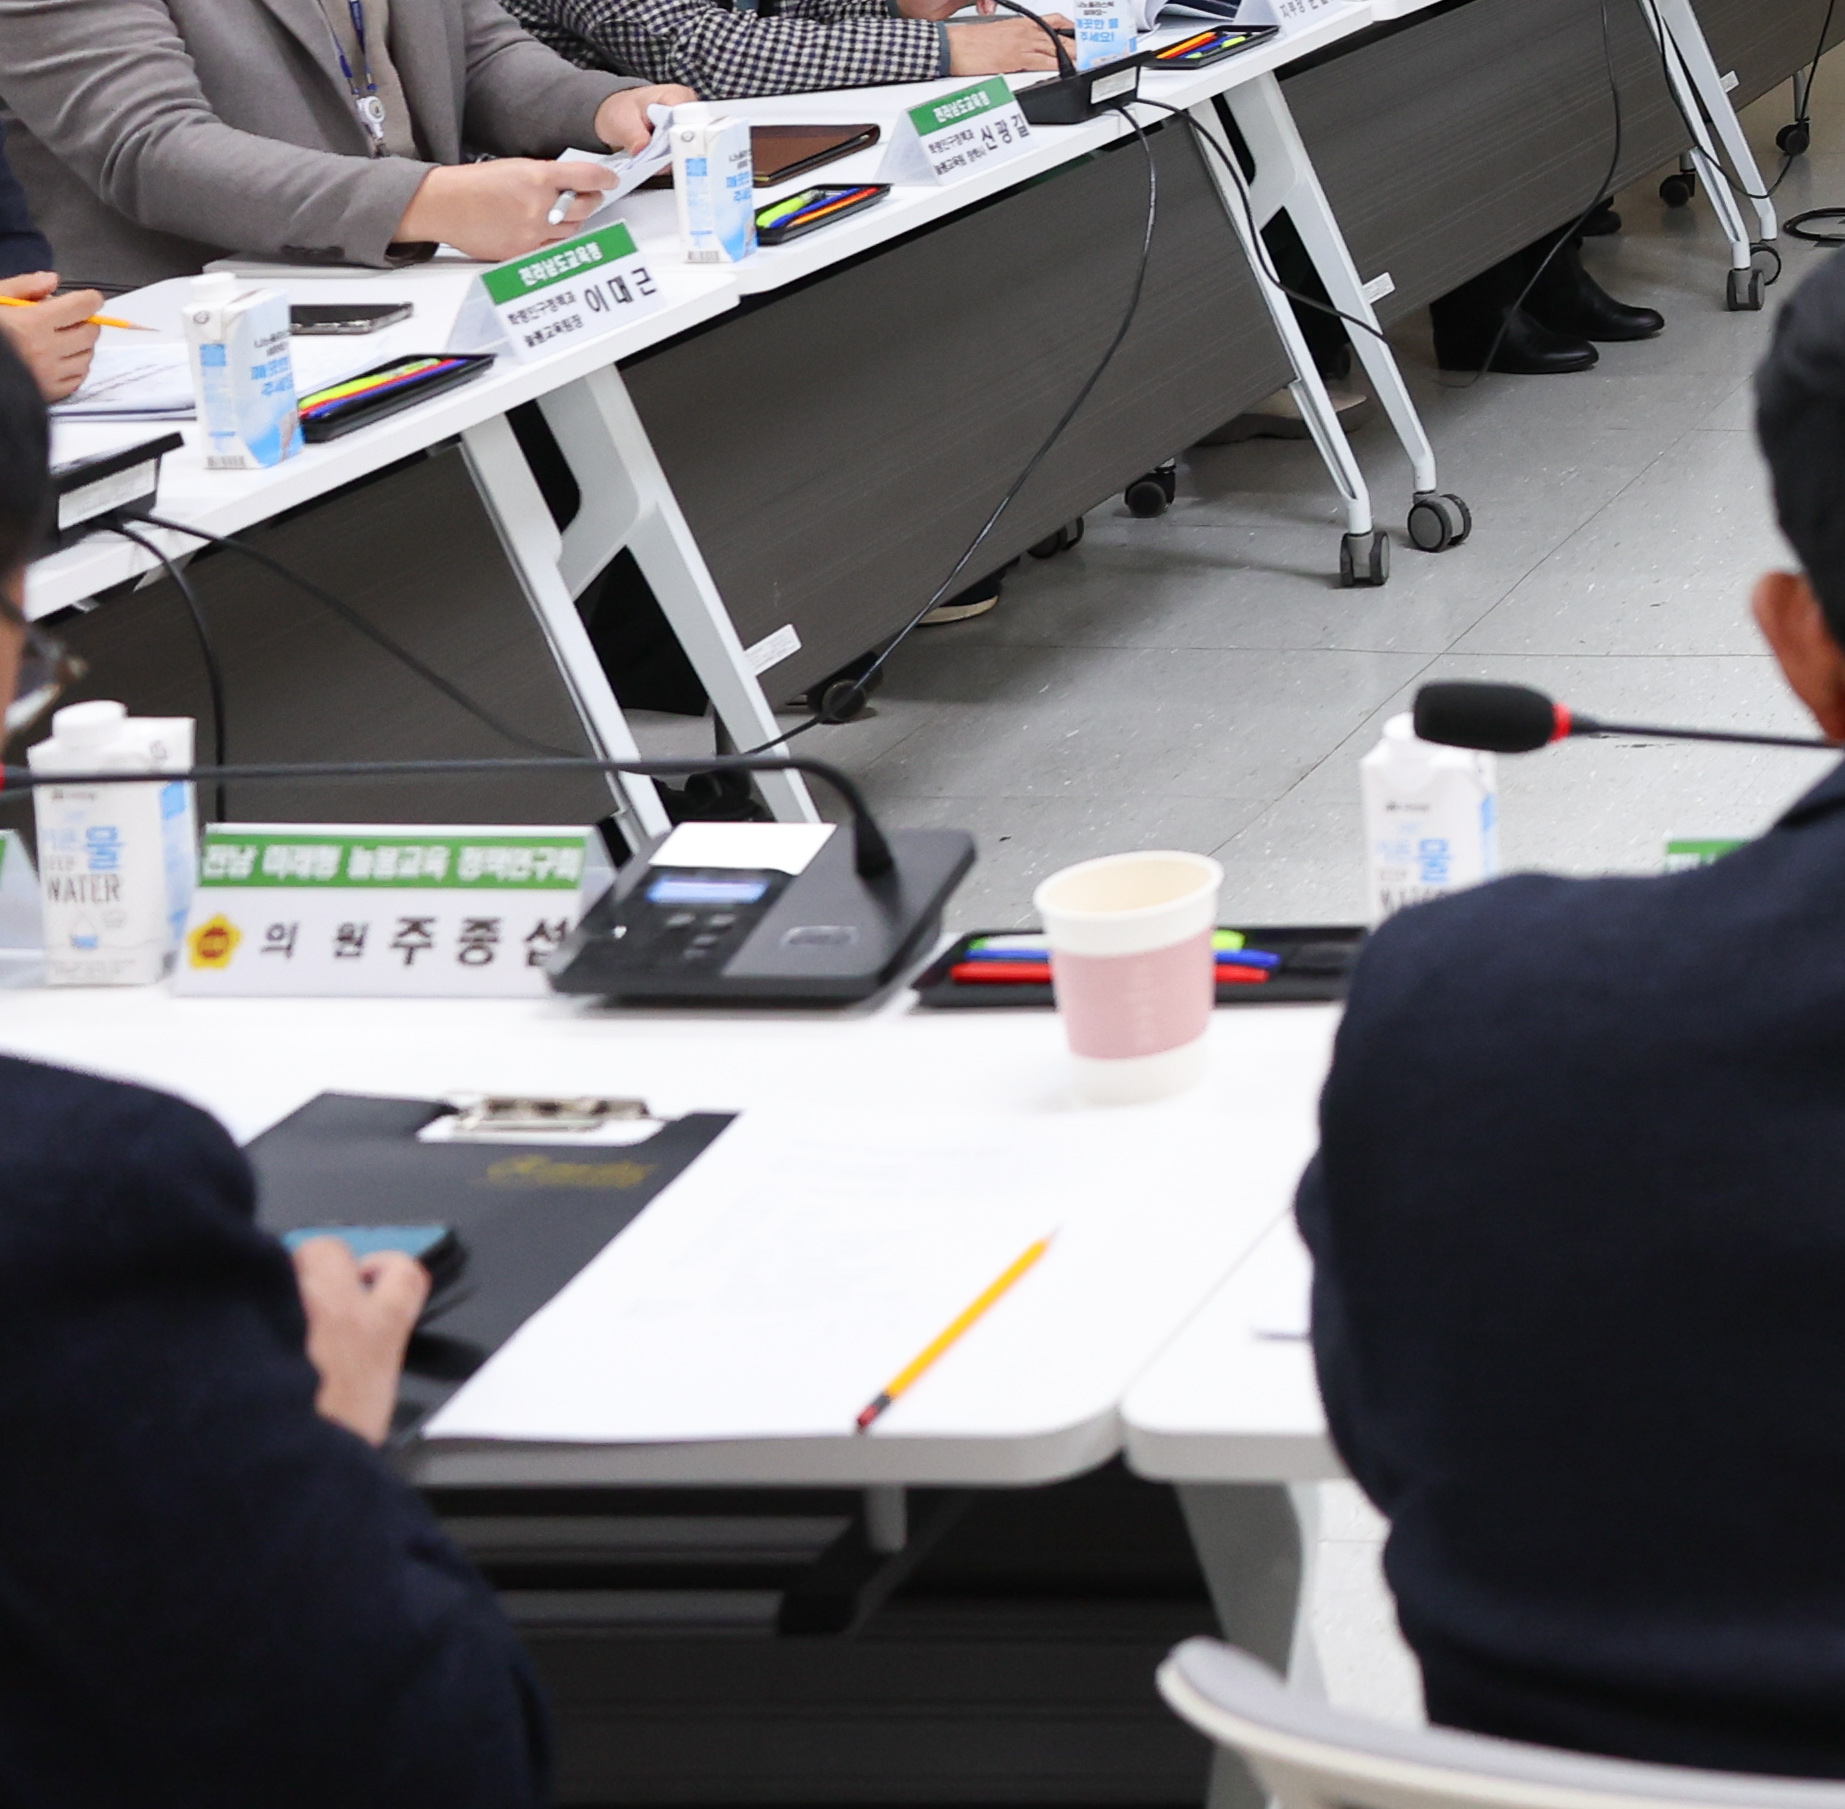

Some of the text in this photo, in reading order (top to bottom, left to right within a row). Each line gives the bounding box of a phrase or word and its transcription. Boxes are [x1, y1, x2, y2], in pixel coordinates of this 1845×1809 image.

[1080, 32, 1114, 42] 주세요!
[933, 90, 991, 123] 전라남도교육청
[981, 113, 1030, 151] 신광길
[518, 241, 603, 287] 전라남도교육청
[584, 267, 658, 312] 이대근
[84, 824, 126, 872] 물
[262, 843, 339, 883] 미래형
[346, 843, 451, 883] 늘봄교육
[457, 843, 584, 886] 정책연구회
[47, 873, 125, 906] WATER
